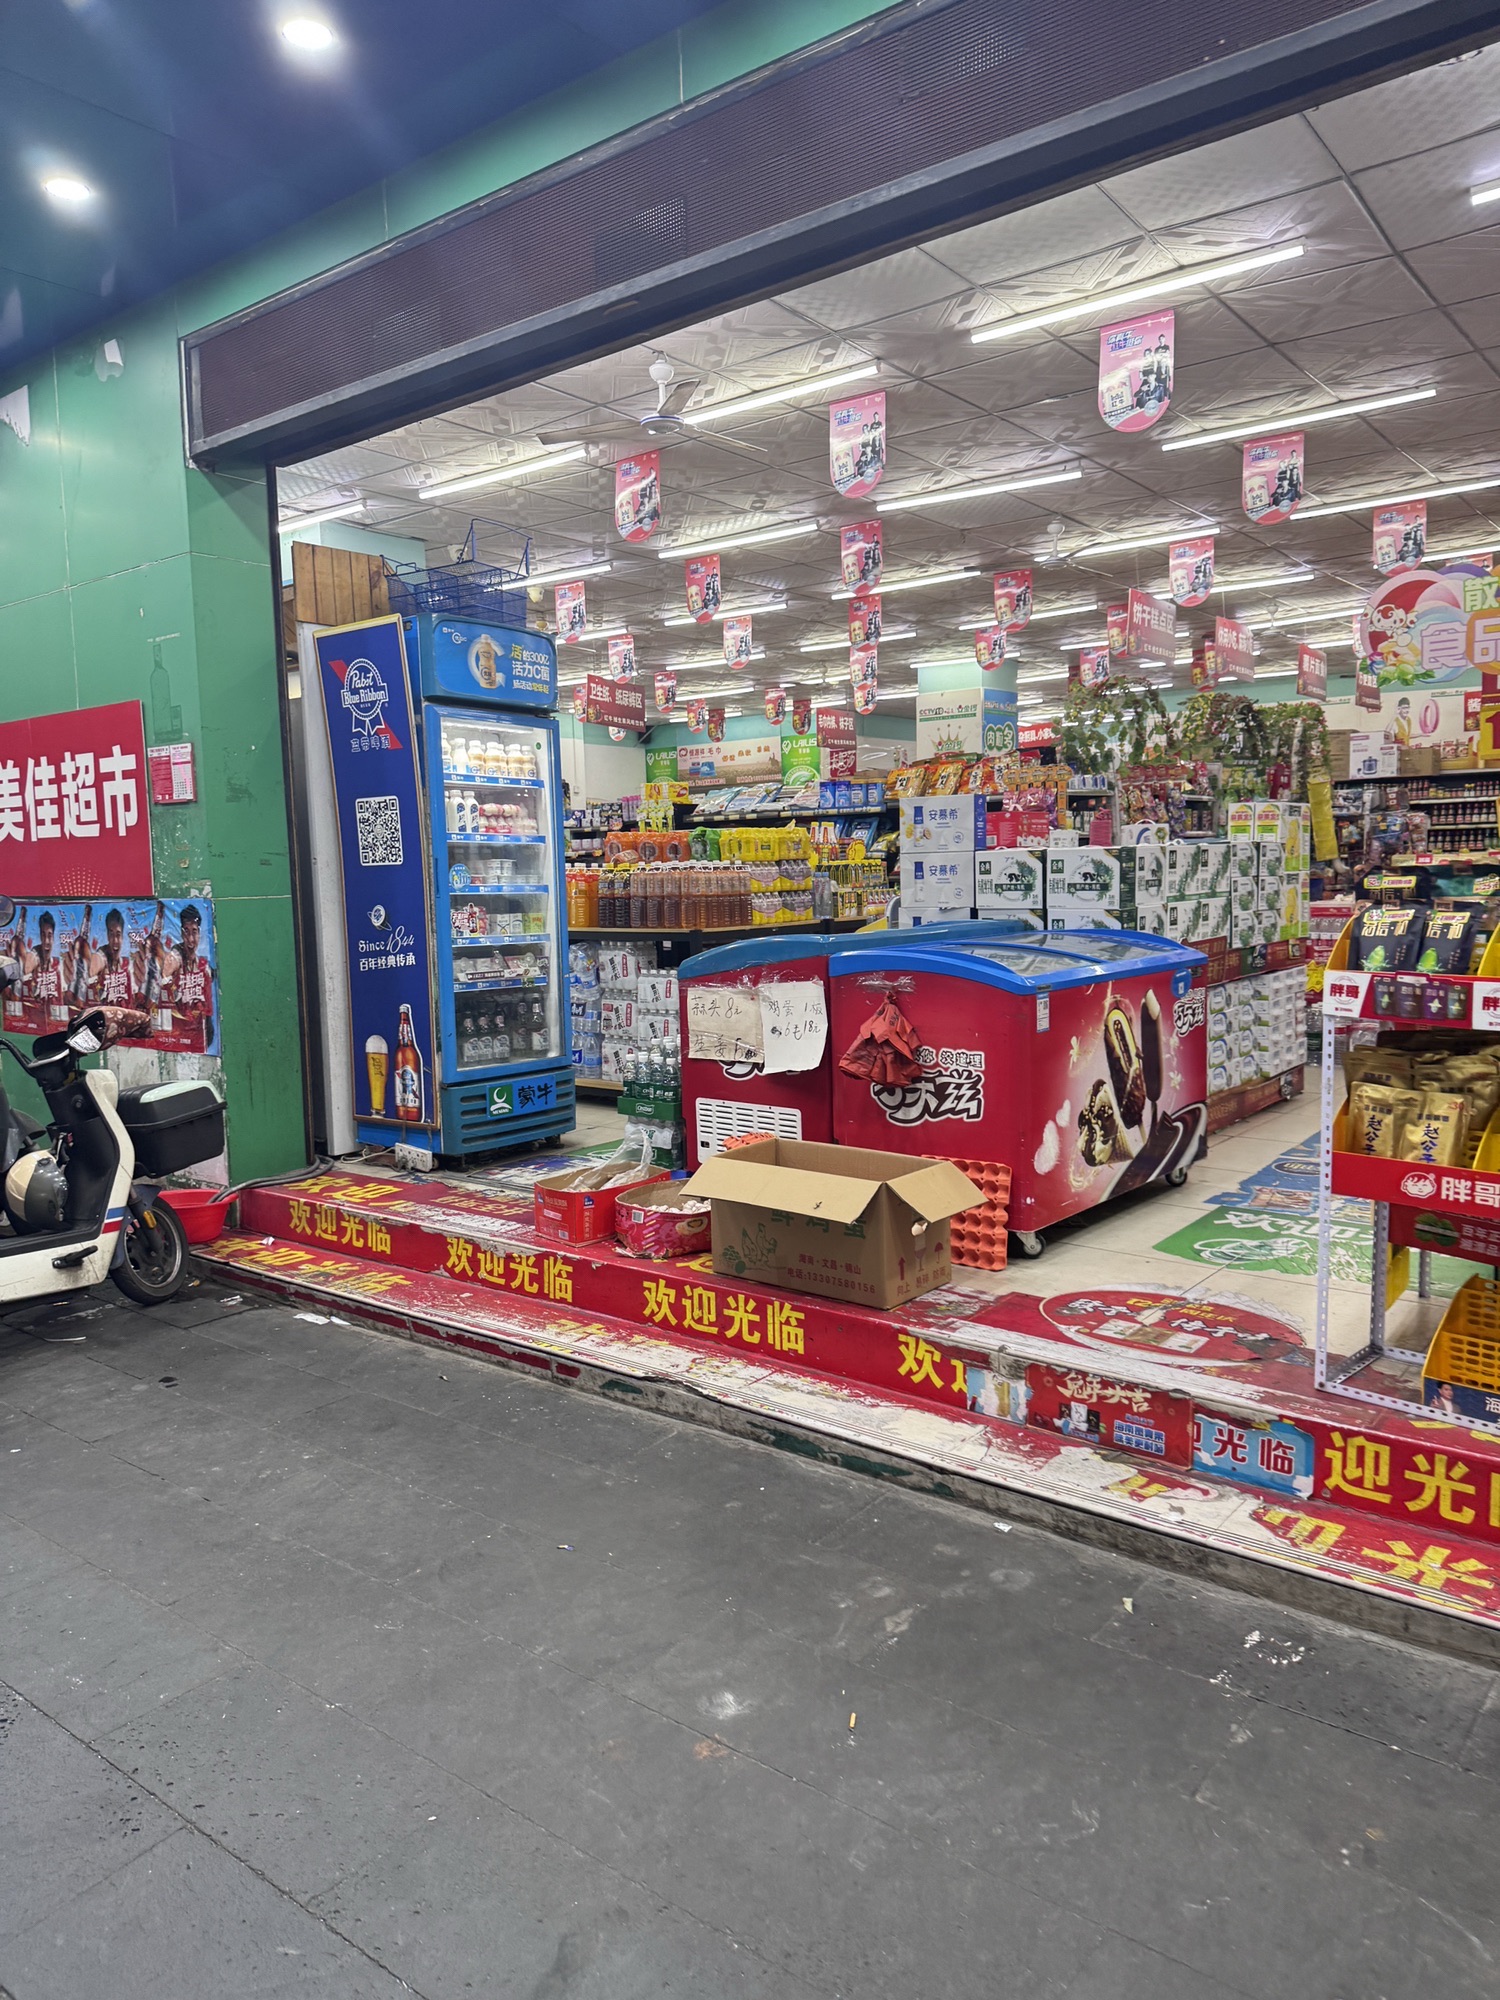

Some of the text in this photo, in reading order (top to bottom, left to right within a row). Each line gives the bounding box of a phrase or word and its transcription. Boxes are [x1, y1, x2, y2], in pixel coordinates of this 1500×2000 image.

[343, 687, 386, 705] Blue Ribbon
[350, 669, 375, 689] Pabst
[0, 744, 138, 843] 美佳超市
[928, 808, 959, 822] 安慕希
[928, 864, 959, 877] 安慕希
[358, 925, 416, 954] Since 1844
[359, 952, 417, 972] 百年经典传承
[517, 1082, 553, 1109] 蒙牛
[1363, 1114, 1383, 1155] 赵公子
[1418, 1123, 1440, 1163] 赵公子
[1440, 1176, 1500, 1208] 胖哥
[288, 1198, 392, 1255] 欢迎光临
[446, 1236, 575, 1303] 欢迎光临
[642, 1279, 806, 1356] 欢迎光临
[1194, 1422, 1297, 1477] 光临
[1322, 1429, 1500, 1530] 迎光
